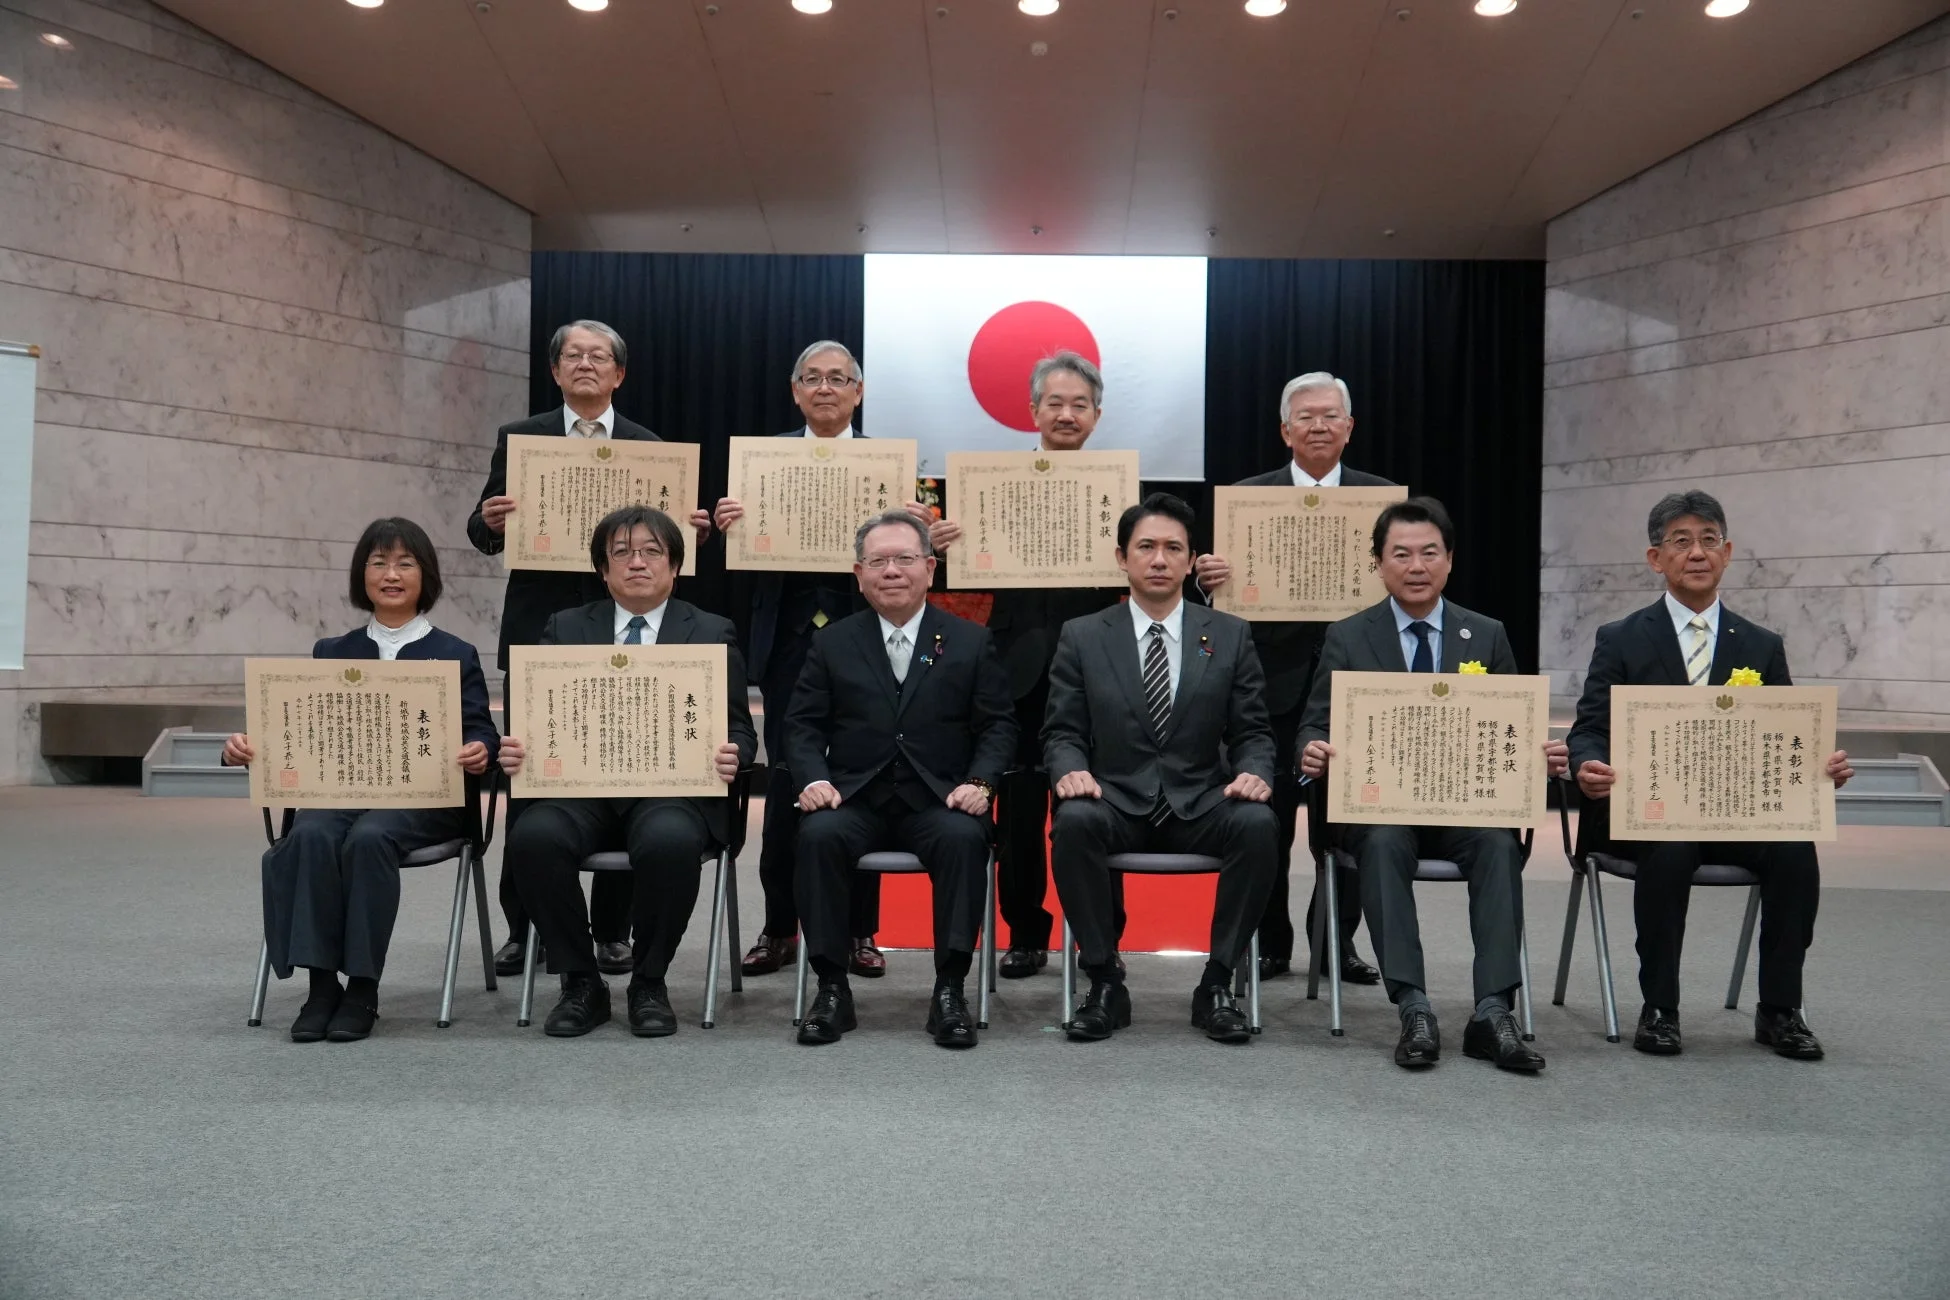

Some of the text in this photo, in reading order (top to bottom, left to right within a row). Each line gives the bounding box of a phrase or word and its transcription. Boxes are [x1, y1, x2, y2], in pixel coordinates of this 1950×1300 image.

[1100, 495, 1112, 538] 表彰状
[416, 709, 432, 757] 表彰状
[684, 693, 698, 741] 表彰状
[1474, 720, 1487, 799] 栃木県芳賀町様
[1502, 724, 1518, 773] 表彰状
[1773, 732, 1784, 812] 栃木県芳賀町様
[1788, 735, 1803, 785] 表彰状
